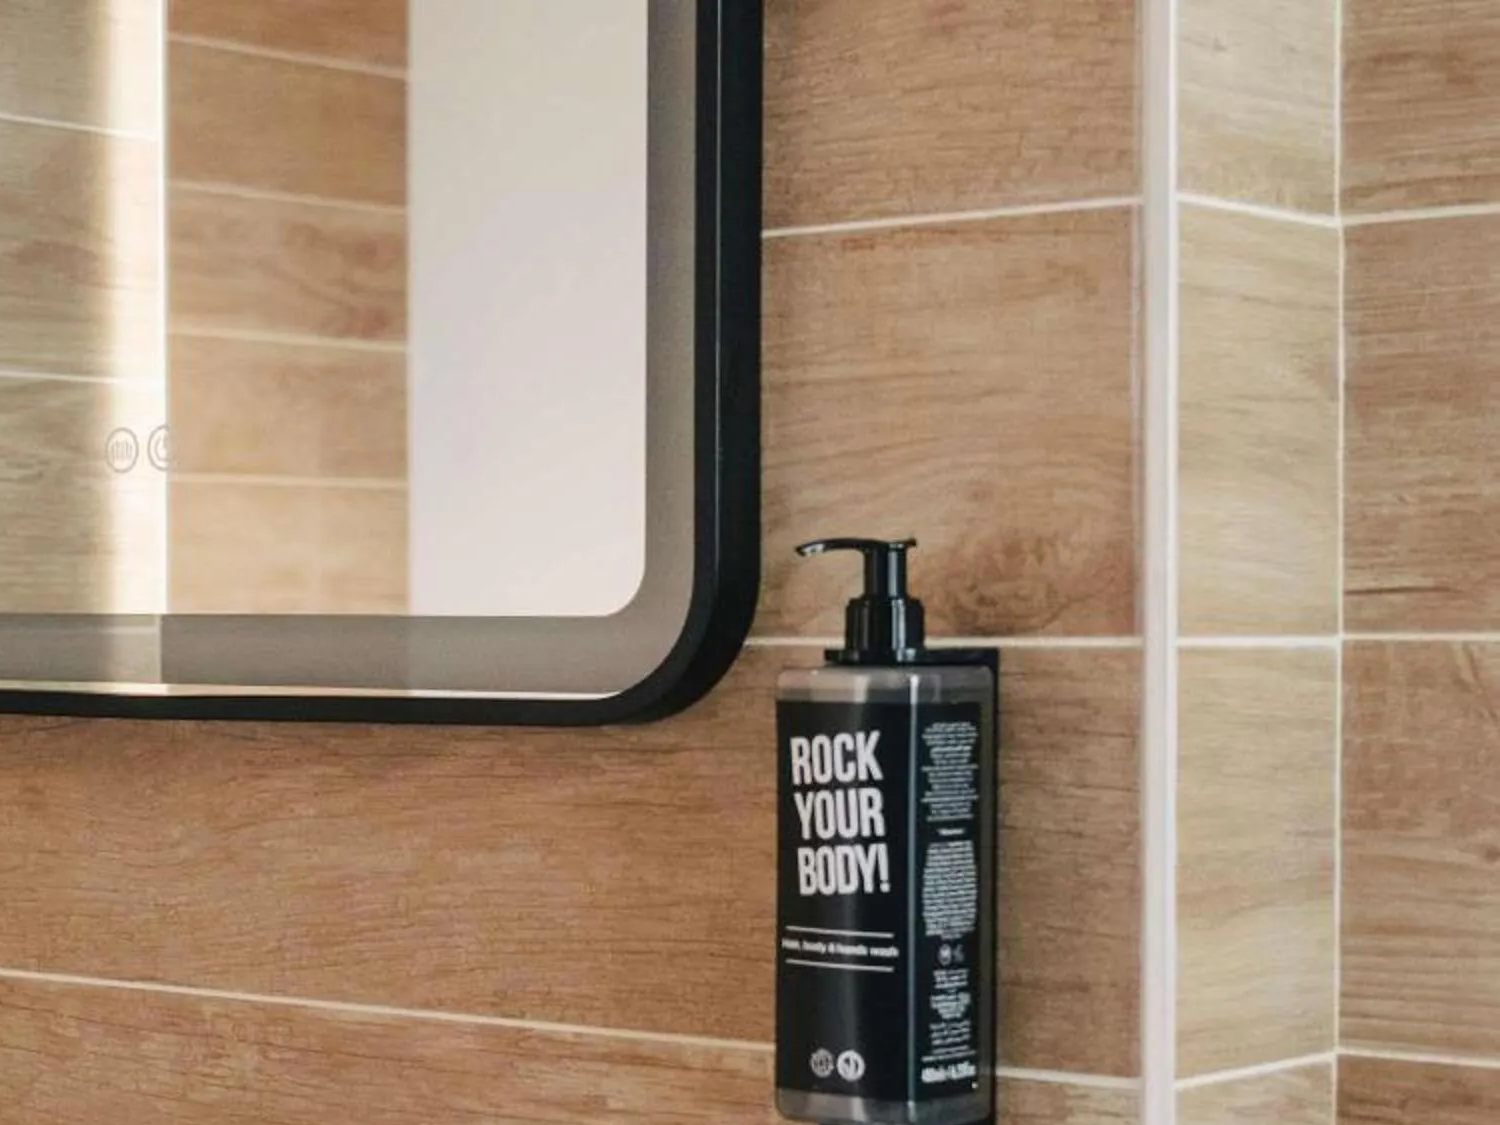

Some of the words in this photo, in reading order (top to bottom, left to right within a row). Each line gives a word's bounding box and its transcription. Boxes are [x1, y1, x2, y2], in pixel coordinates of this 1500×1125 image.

[790, 730, 883, 785] ROCK
[793, 787, 886, 840] YOUR
[797, 843, 891, 896] BODY!
